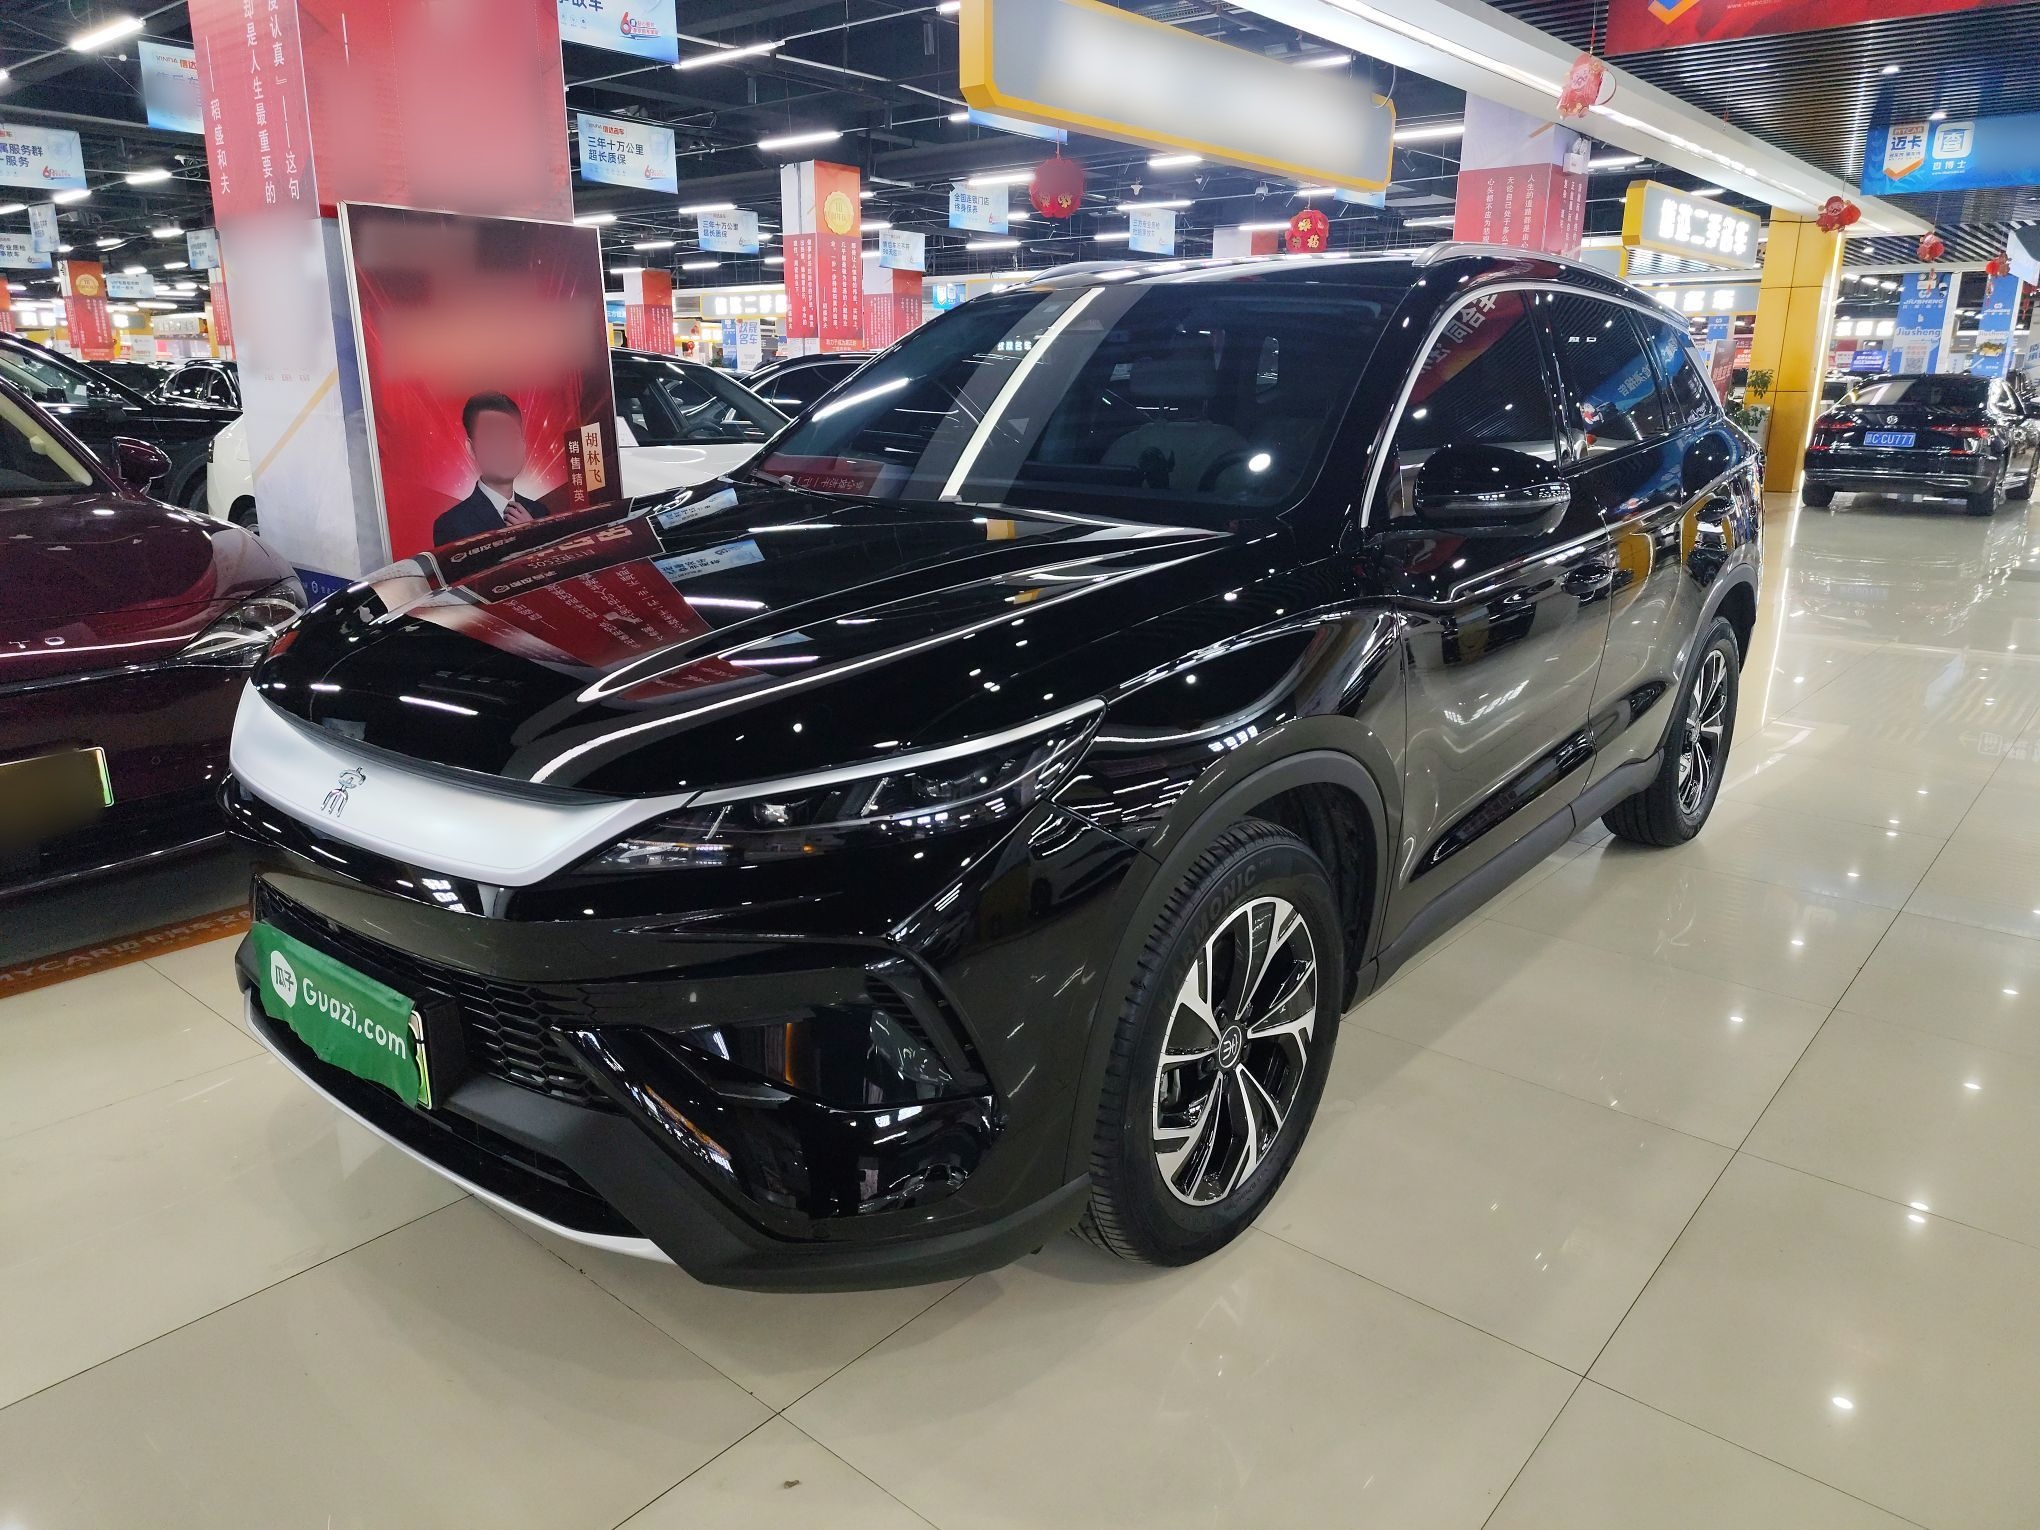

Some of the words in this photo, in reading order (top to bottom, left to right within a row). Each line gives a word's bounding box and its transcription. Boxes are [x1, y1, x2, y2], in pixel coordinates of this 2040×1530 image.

[588, 136, 645, 156] 三年十万公里
[1891, 135, 1922, 151] 迈卡
[588, 148, 627, 165] 超长质保
[1501, 176, 1516, 245] 无论自己处于多么
[702, 220, 739, 231] 三年十万公里
[1896, 326, 1942, 338] Jiusheng
[585, 432, 602, 483] 胡林飞
[568, 440, 585, 502] 销售精英
[273, 964, 295, 992] 瓜子
[302, 977, 407, 1060] Guazi.com
